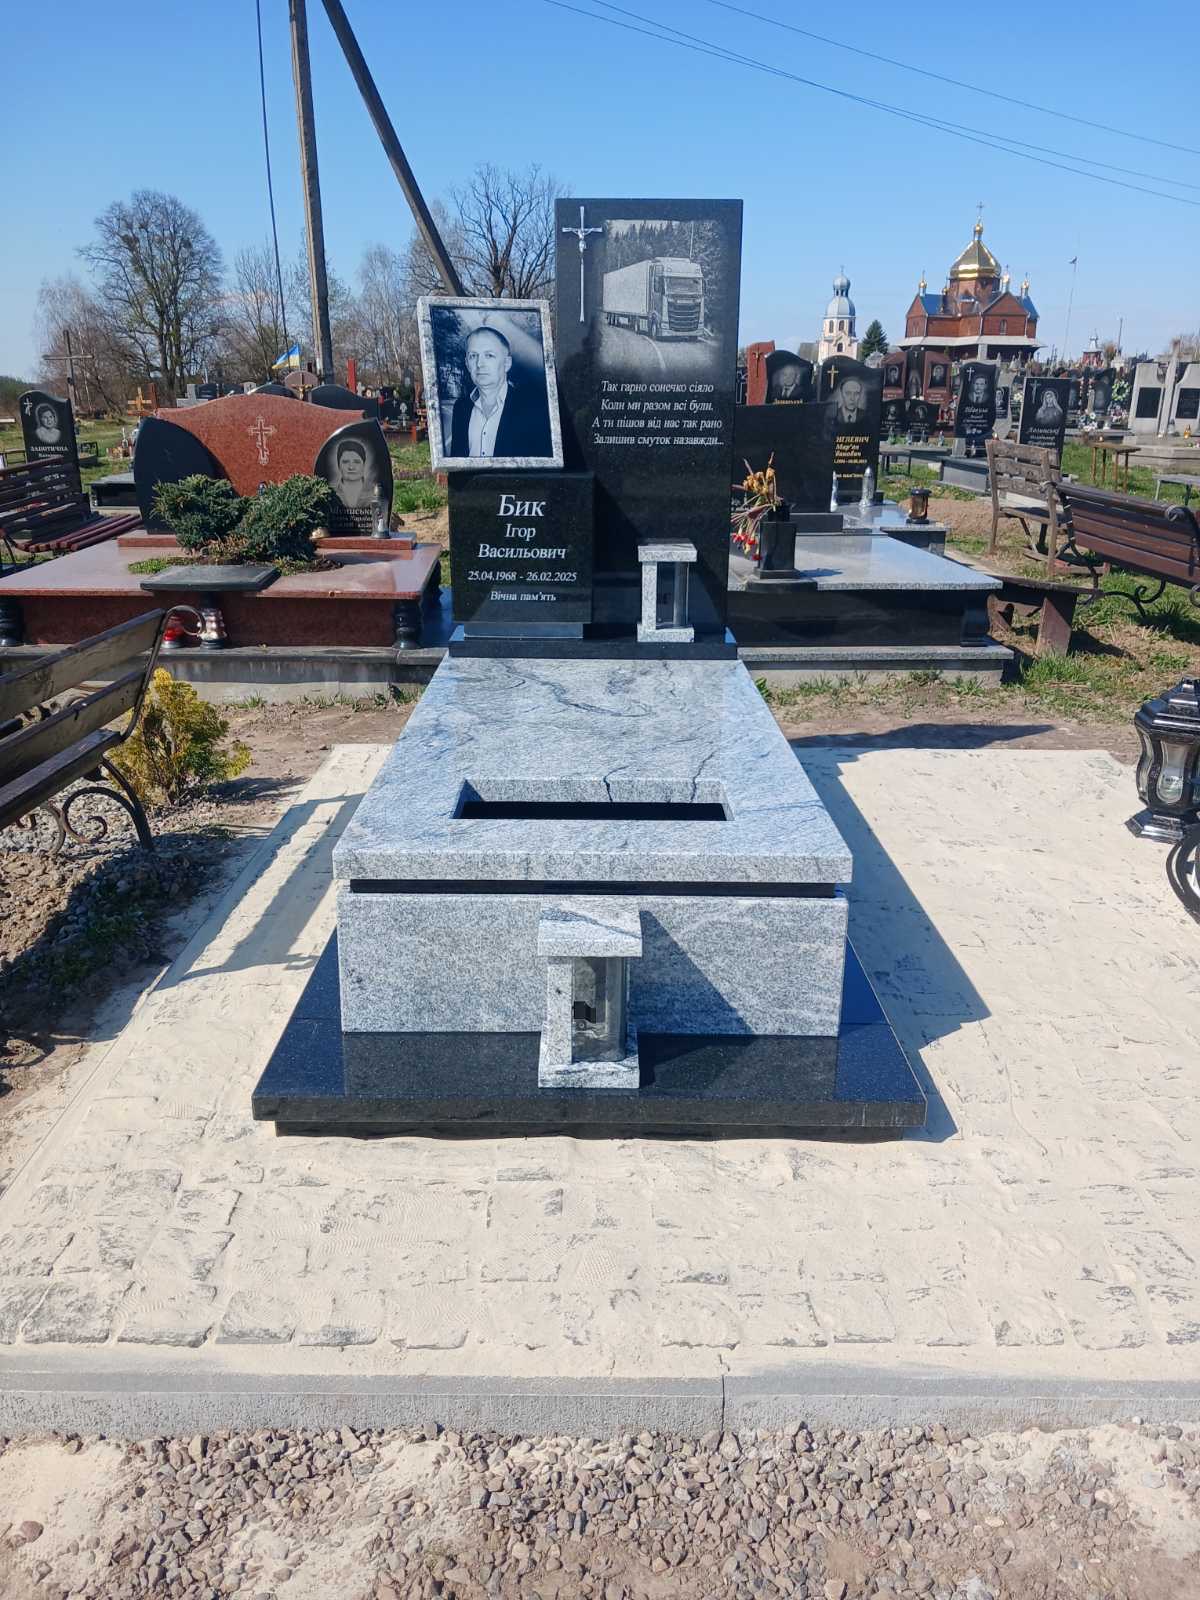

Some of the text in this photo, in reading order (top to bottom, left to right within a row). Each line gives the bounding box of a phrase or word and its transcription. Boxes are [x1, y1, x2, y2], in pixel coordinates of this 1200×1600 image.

[601, 381, 714, 394] Так гарно сонечко сіяло
[601, 399, 624, 410] Коли
[627, 401, 641, 410] ми
[643, 401, 670, 413] разом
[674, 400, 687, 411] всі
[592, 416, 722, 431] А ти пішов від нас так рано
[594, 433, 635, 444] Залишив
[638, 436, 670, 447] смуток
[497, 494, 546, 516] Бик
[505, 523, 536, 541] Ігор
[478, 544, 567, 559] Васильович
[468, 571, 517, 581] 25.04.1968
[526, 572, 577, 582] 26.02.2025
[490, 591, 556, 601] Вічна пам'ять
